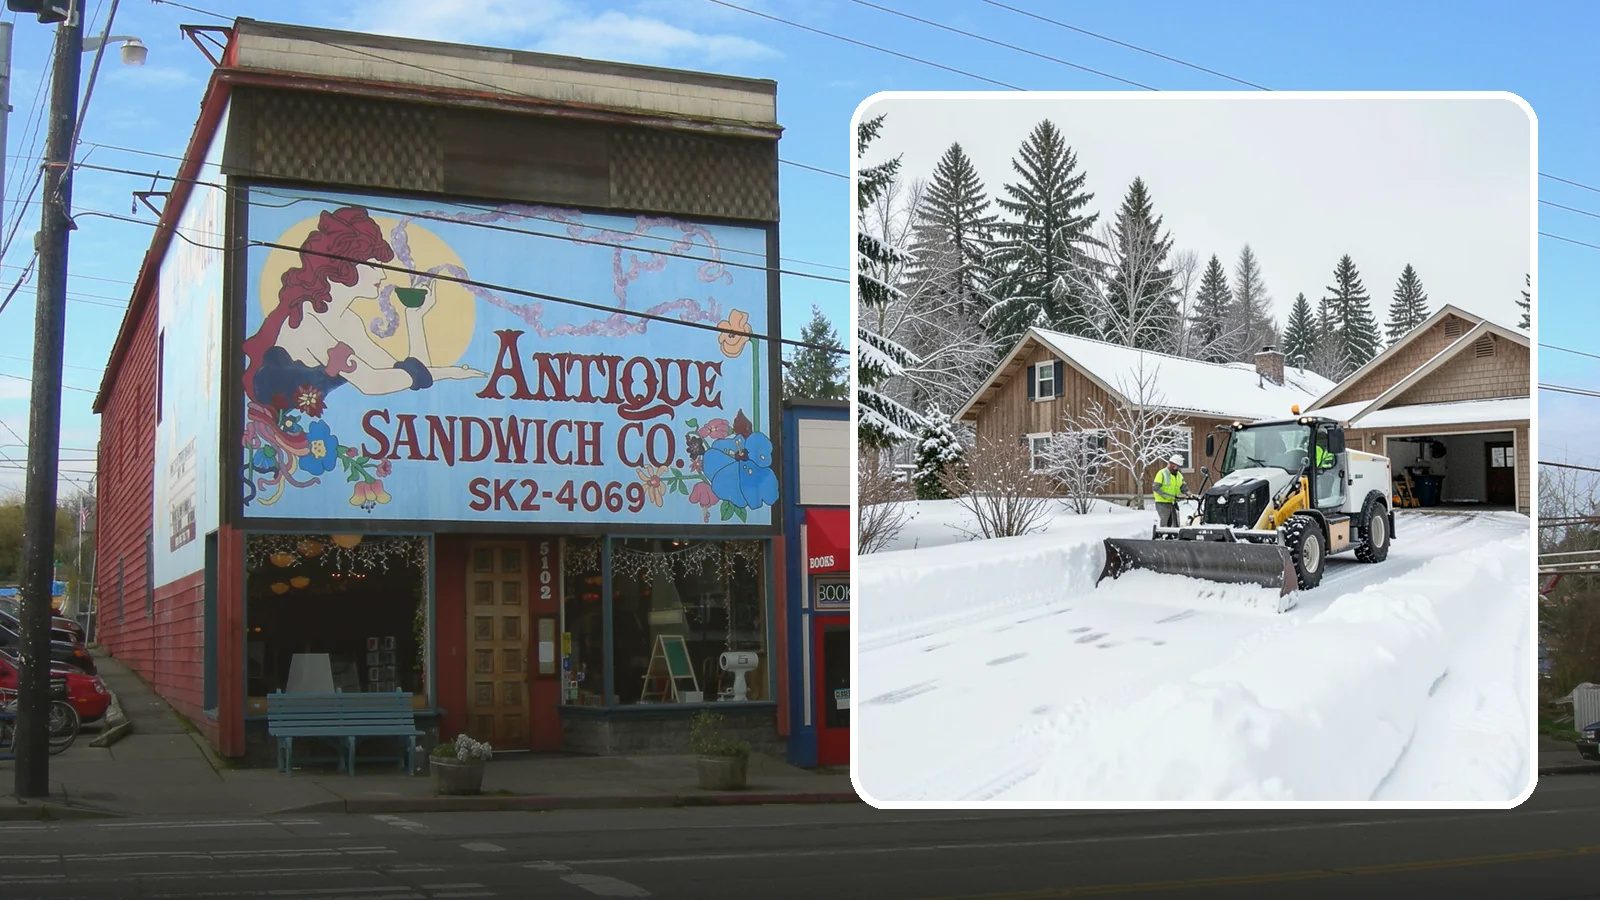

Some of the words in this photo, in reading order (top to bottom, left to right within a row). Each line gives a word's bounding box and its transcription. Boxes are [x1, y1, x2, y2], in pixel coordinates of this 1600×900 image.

[361, 409, 605, 467] SANDWICH
[617, 422, 685, 469] CO.
[468, 477, 646, 513] SK2-4069
[540, 542, 552, 600] 5102
[809, 555, 835, 568] BOOKS
